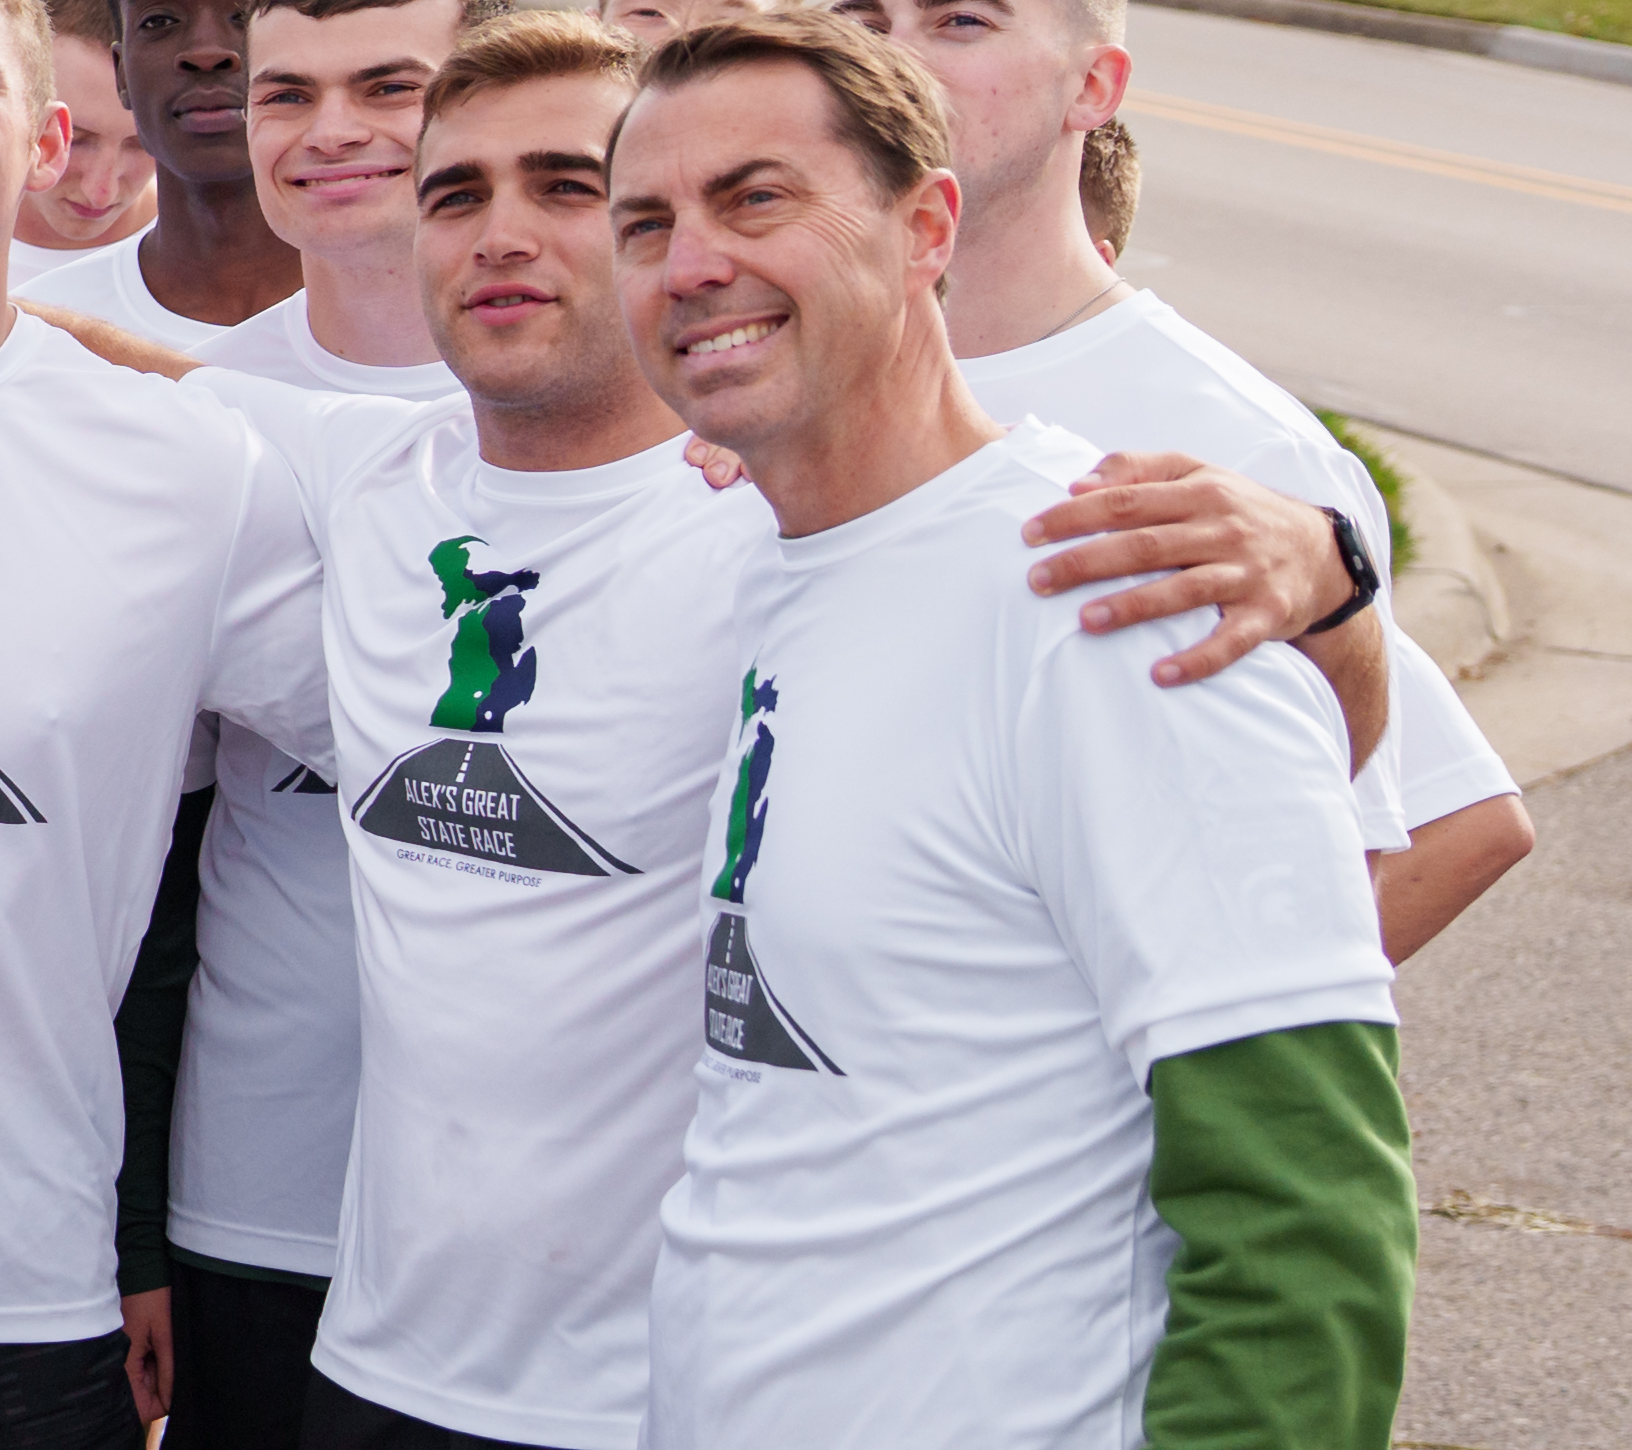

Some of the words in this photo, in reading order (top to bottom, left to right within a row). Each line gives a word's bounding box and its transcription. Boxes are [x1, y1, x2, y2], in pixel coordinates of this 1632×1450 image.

[405, 777, 457, 812] ALEX'S
[462, 788, 521, 821] GREAT
[417, 815, 469, 848] STATE
[469, 826, 517, 858] RACE
[397, 849, 424, 863] GREAT
[456, 861, 496, 879] GREATER
[499, 871, 542, 888] PURPOSE
